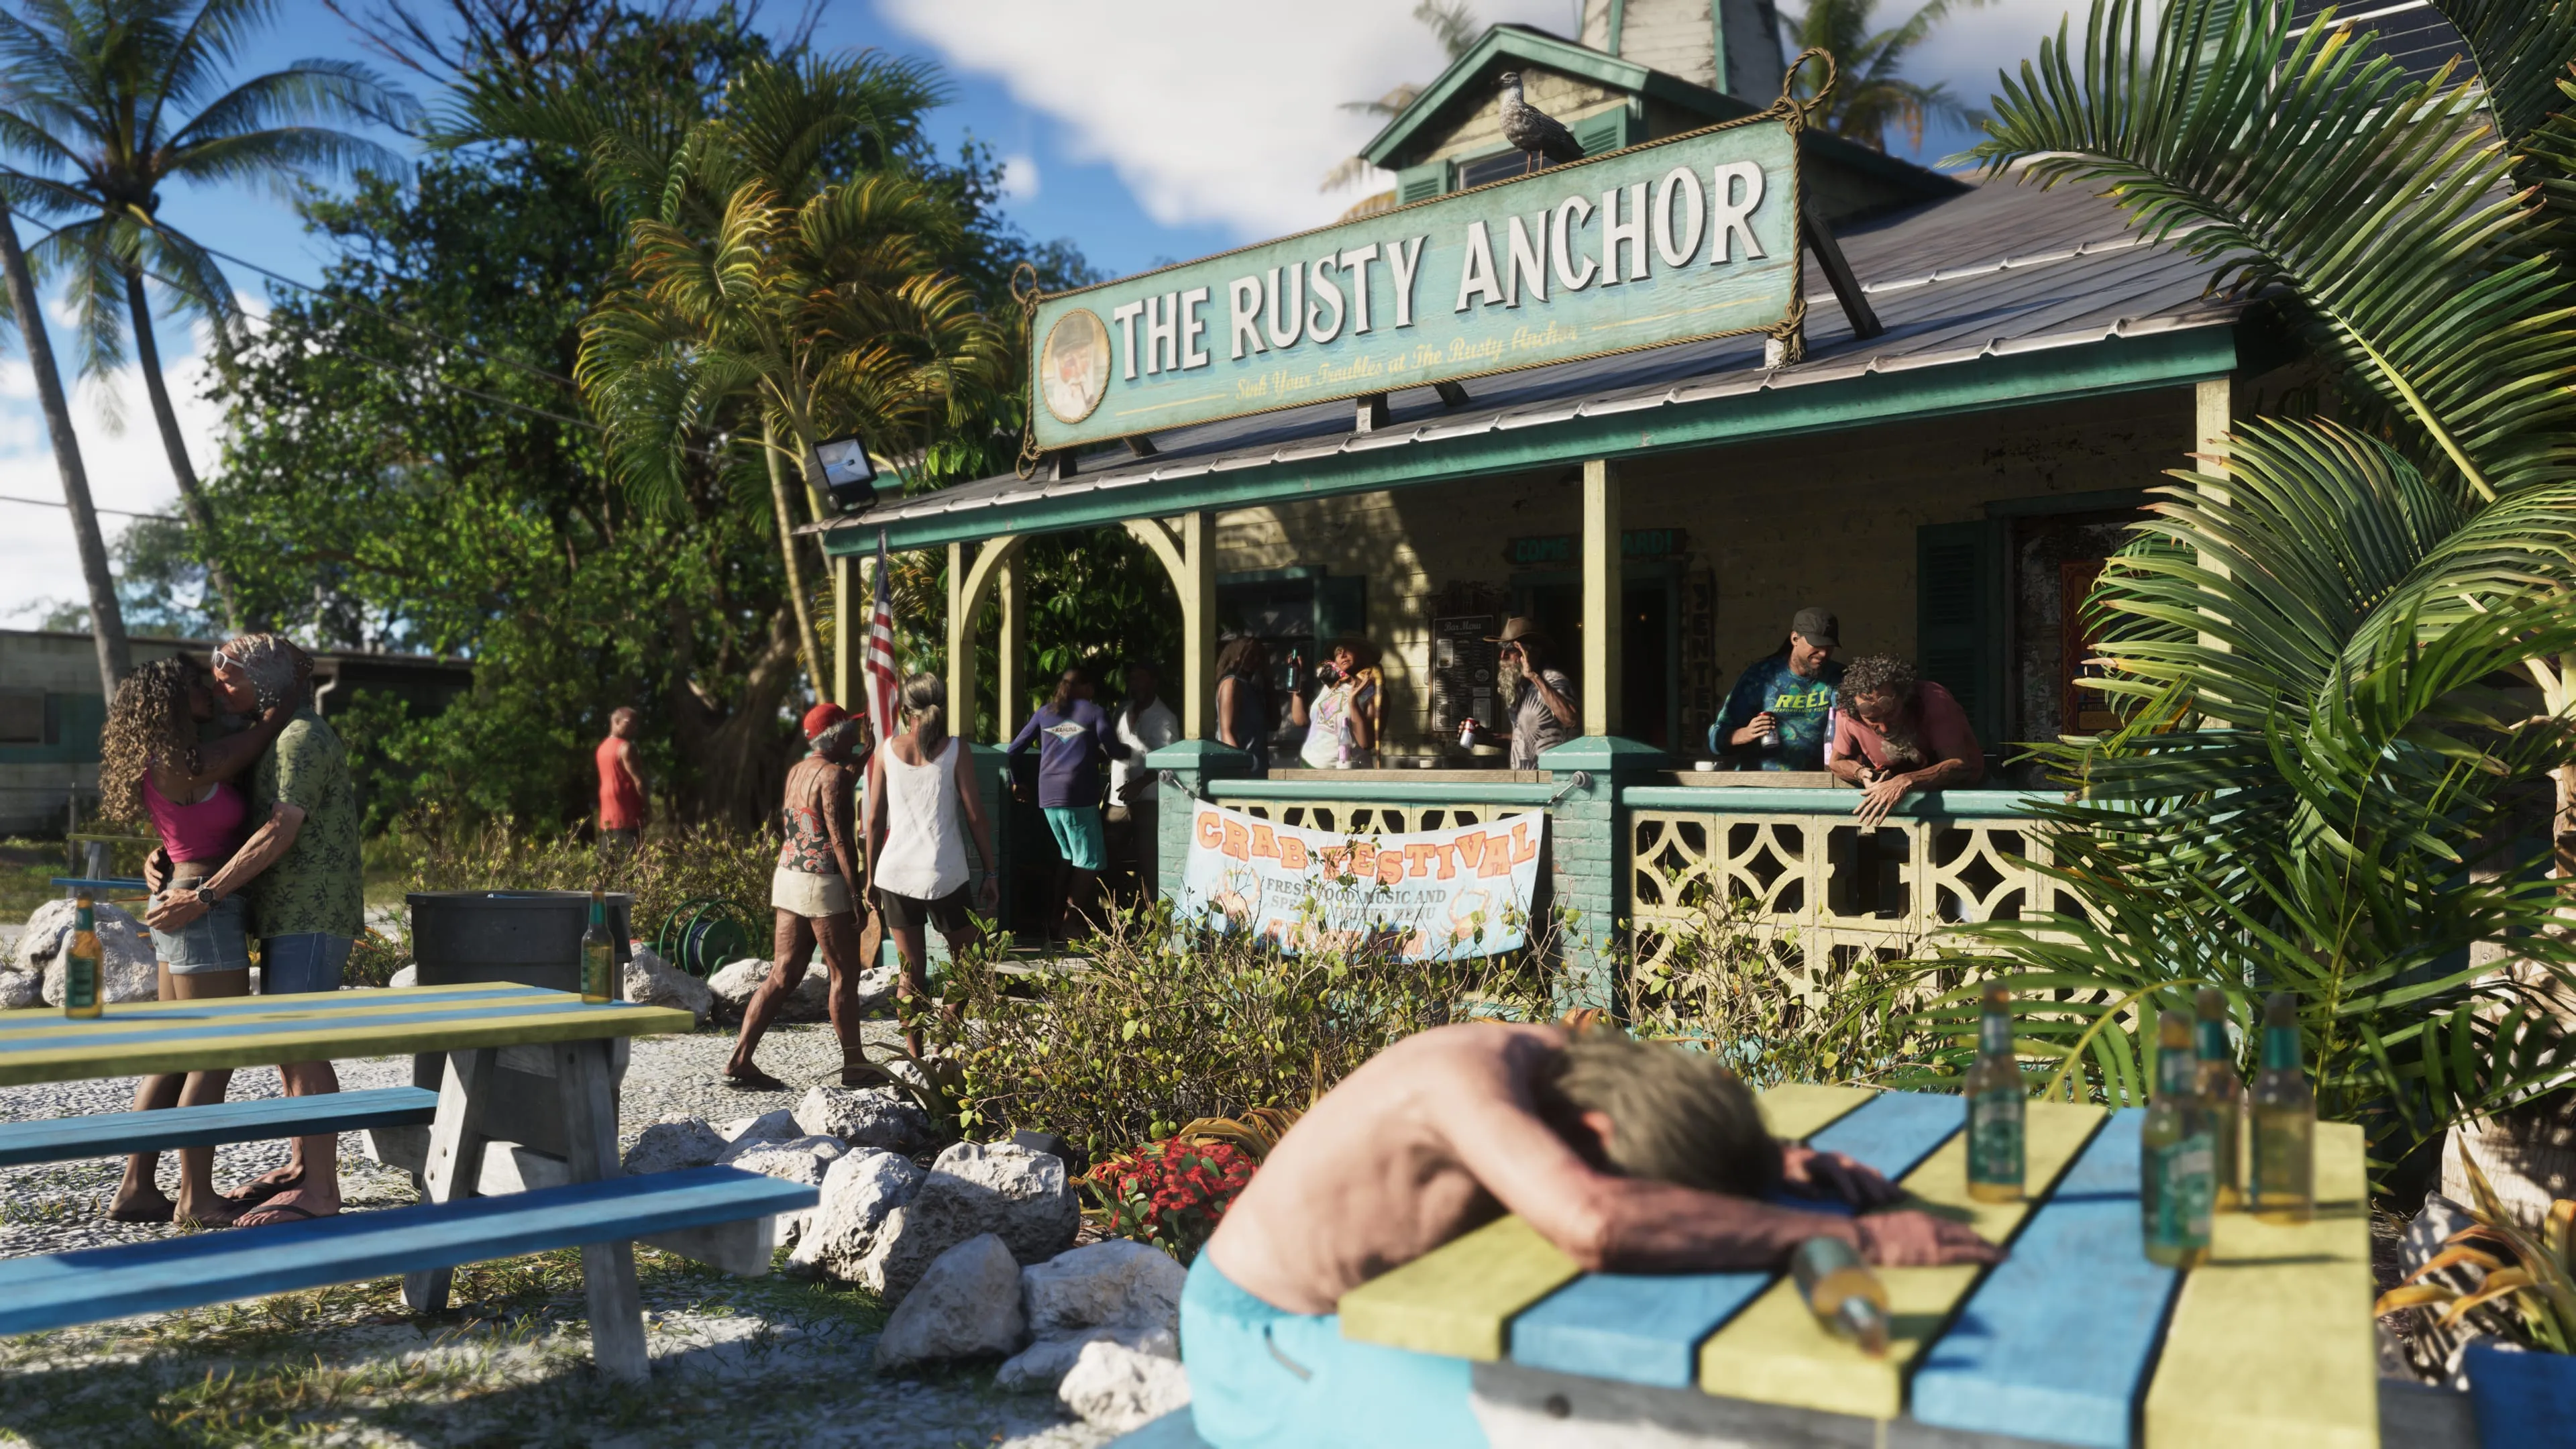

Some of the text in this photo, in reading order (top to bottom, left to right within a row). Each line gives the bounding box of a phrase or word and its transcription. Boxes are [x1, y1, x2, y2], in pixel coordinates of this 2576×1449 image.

[1114, 160, 1768, 382] THE RUSTY ANCHOR
[1236, 320, 1578, 400] Sink Your Troubles at The Rusty Anchor
[1515, 537, 1570, 562] COME
[1444, 620, 1482, 632] Bar Menu
[1774, 686, 1829, 708] REEL
[1197, 811, 1536, 885] CRAB FESTIVAL
[1363, 890, 1410, 905] MUSIC
[1413, 890, 1446, 903] AND
[1391, 907, 1436, 921] MENU
